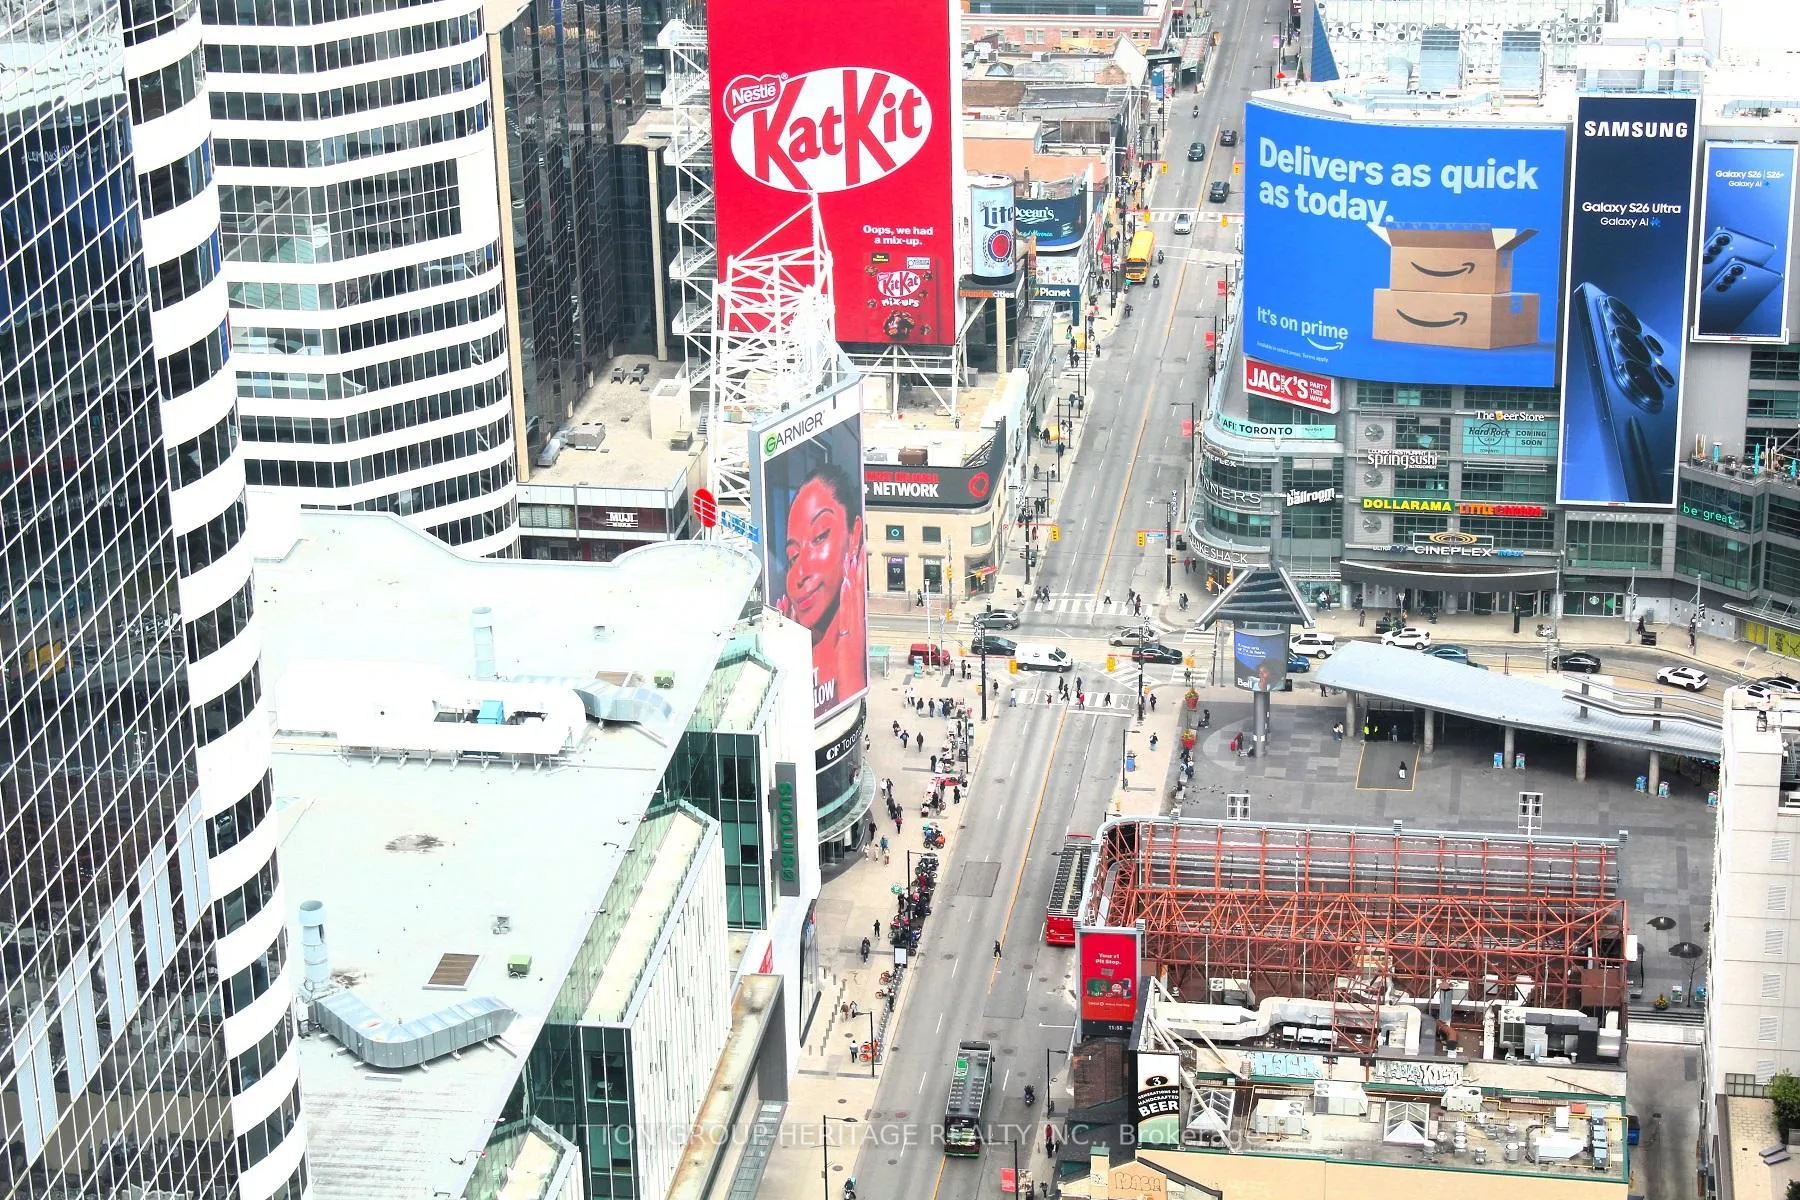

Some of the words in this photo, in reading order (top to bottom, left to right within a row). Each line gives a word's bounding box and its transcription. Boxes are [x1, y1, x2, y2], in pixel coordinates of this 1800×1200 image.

[732, 82, 775, 106] Nestlé
[1584, 121, 1688, 138] SAMSUNG
[1260, 136, 1384, 186] Delivers
[1391, 162, 1431, 188] as
[1440, 158, 1539, 194] quick
[1715, 170, 1746, 180] Galaxy
[1747, 170, 1762, 178] S26
[1728, 181, 1753, 189] Galaxy
[1259, 181, 1289, 208] as
[1296, 184, 1394, 224] today.
[1582, 202, 1627, 215] Galaxy
[1629, 202, 1650, 213] S26
[1652, 203, 1681, 214] Ultra
[1600, 217, 1637, 228] Galaxy
[1639, 217, 1648, 226] AI
[863, 225, 894, 236] Oops,
[912, 226, 933, 235] had
[883, 237, 922, 247] mix-up.
[1040, 287, 1071, 297] Planet
[1257, 306, 1278, 326] It's
[1280, 316, 1298, 332] on
[1301, 320, 1349, 341] prime
[1248, 368, 1309, 399] JACK'S
[1310, 382, 1327, 391] PARTY
[1477, 411, 1494, 420] The
[1520, 412, 1545, 421] Store
[1240, 424, 1293, 435] TORONTO
[1468, 427, 1489, 436] Hard
[1490, 427, 1511, 437] Rock
[1368, 454, 1408, 470] spring
[1409, 451, 1437, 465] sushi
[873, 482, 939, 497] NETWORK
[1364, 499, 1452, 511] DOLLARAMA
[1460, 503, 1494, 515] LITTLE
[1683, 502, 1697, 516] be
[1211, 546, 1248, 563] SHACK
[1414, 545, 1492, 557] CINEPLEX
[1238, 677, 1253, 689] Bell
[814, 679, 835, 708] LOW
[1153, 1077, 1161, 1086] 3
[1138, 1095, 1179, 1106] HANDCRAFTED
[1138, 1100, 1179, 1117] BEER
